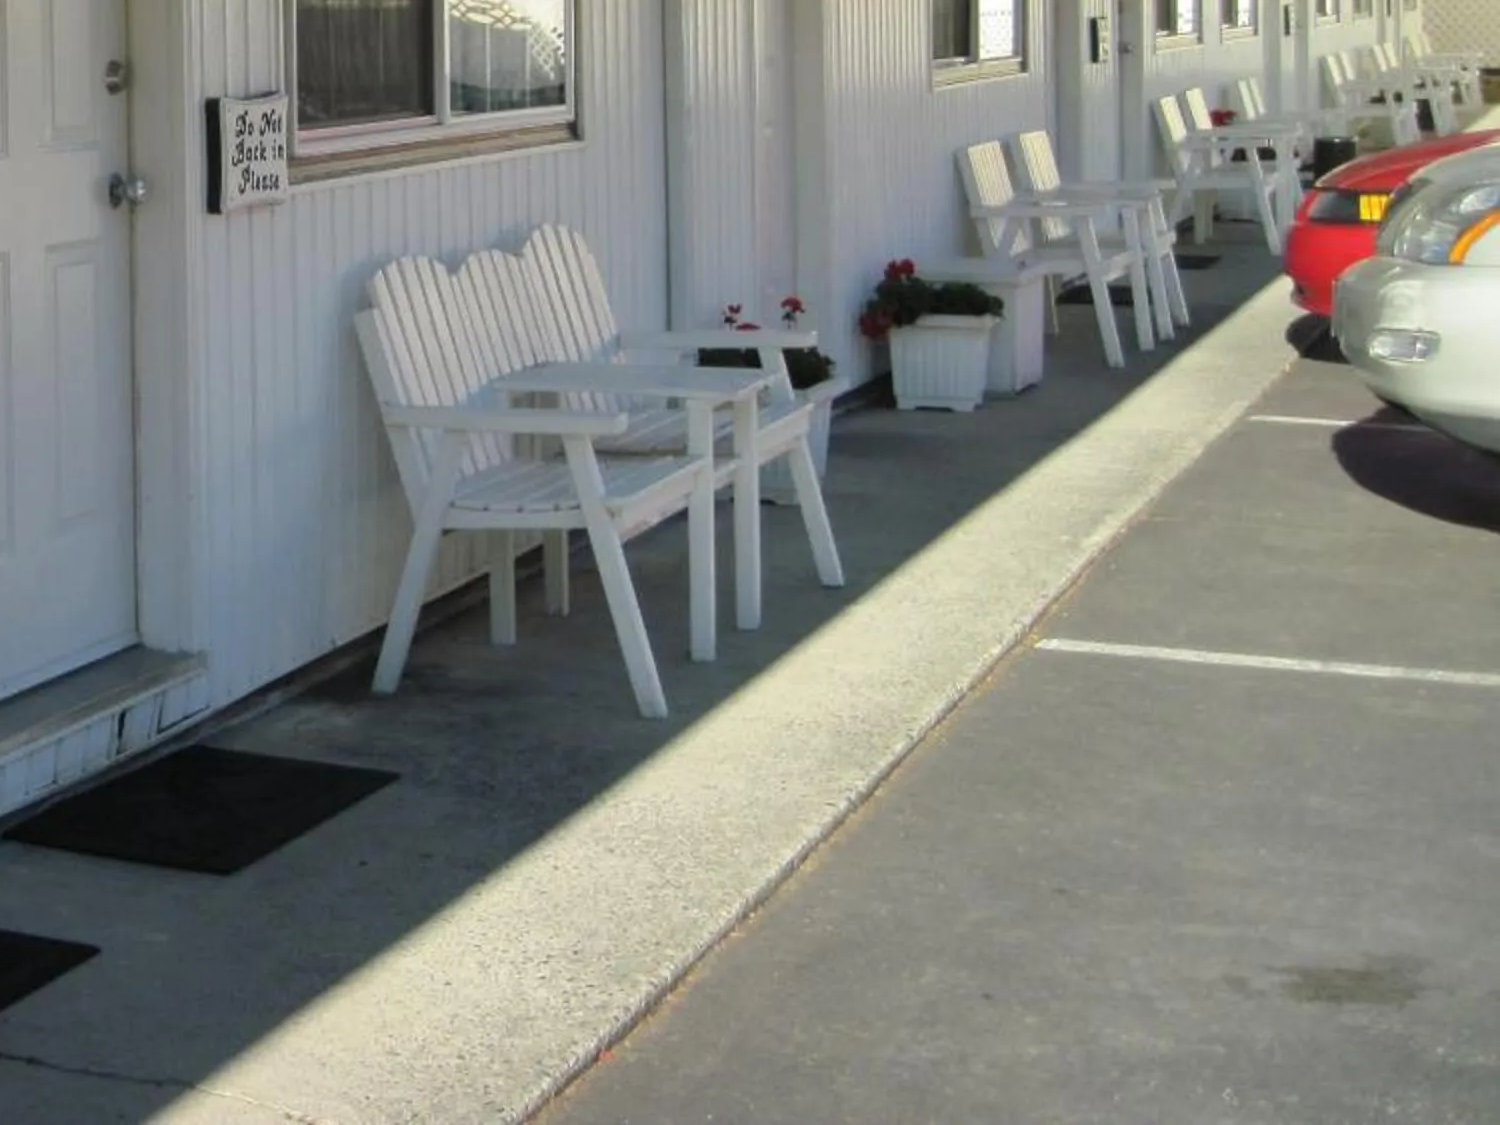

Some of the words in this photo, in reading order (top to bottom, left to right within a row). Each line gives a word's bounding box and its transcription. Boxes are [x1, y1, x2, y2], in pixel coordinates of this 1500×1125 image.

[235, 110, 254, 137] Do
[260, 108, 282, 137] Not
[232, 138, 267, 167] Back
[238, 164, 279, 194] Please
